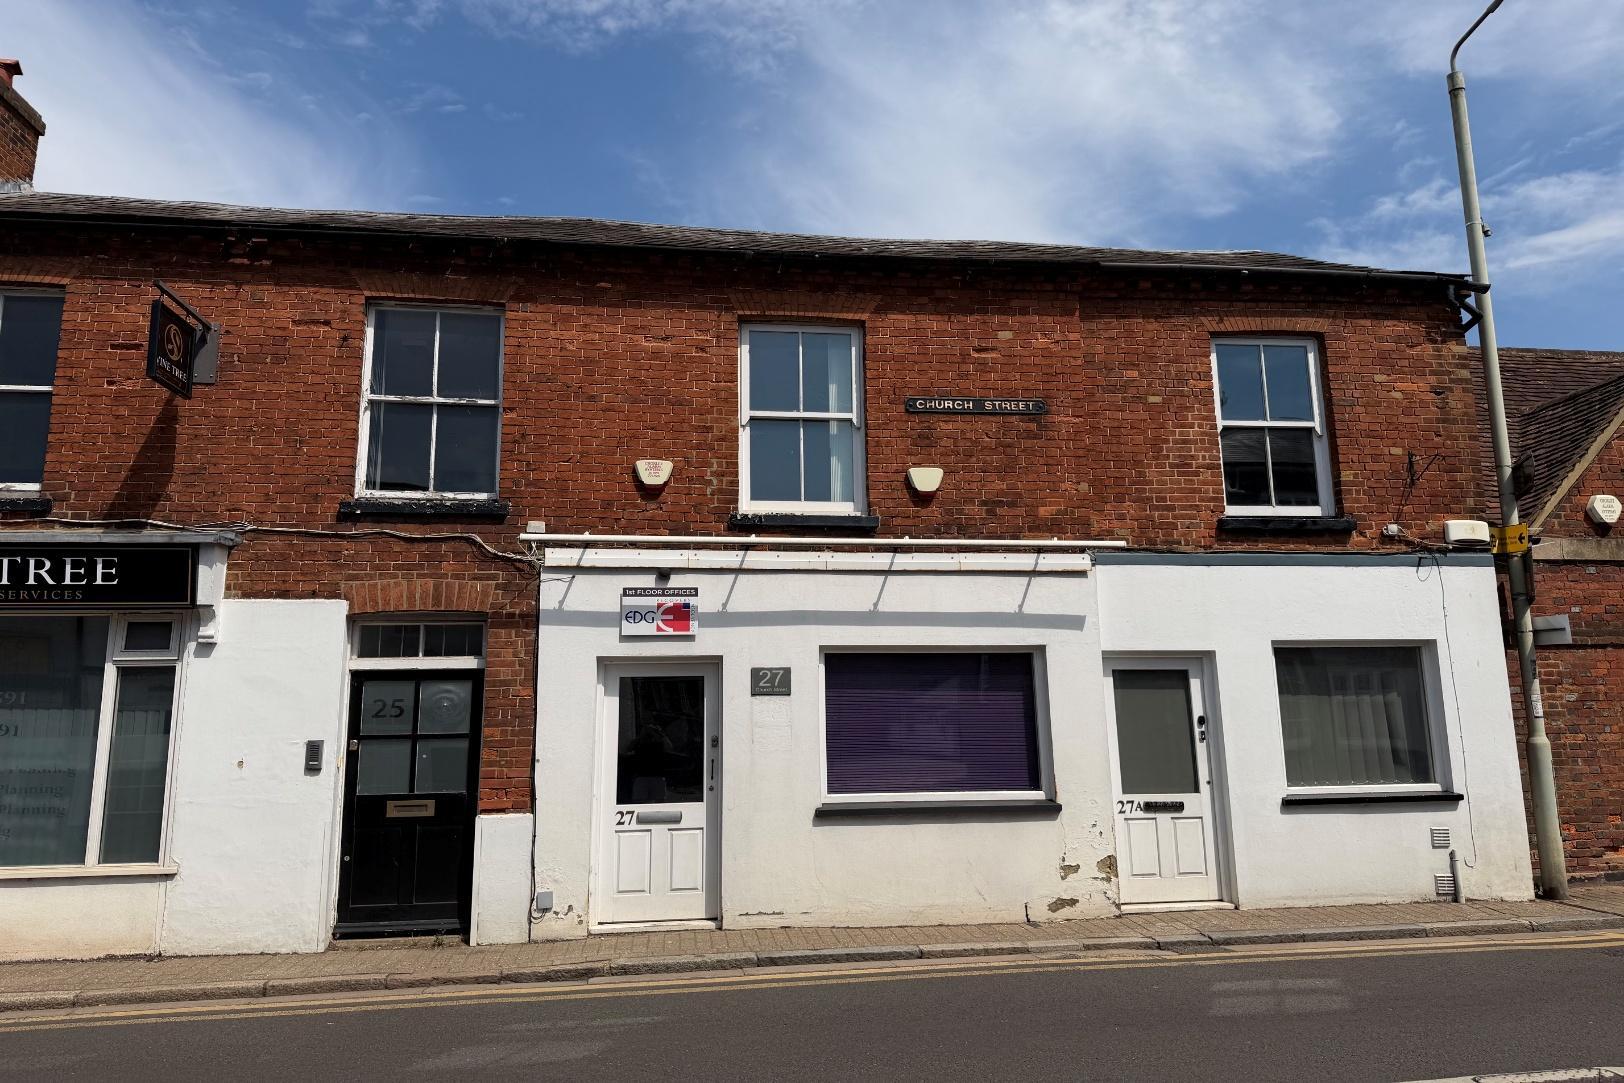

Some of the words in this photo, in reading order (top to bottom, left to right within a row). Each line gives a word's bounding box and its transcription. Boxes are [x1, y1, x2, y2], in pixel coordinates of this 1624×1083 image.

[171, 365, 187, 382] TREE
[916, 400, 973, 410] CHURCH
[984, 401, 1036, 411] STREET
[0, 556, 119, 585] TREE
[0, 590, 83, 600] SERVICES
[759, 670, 785, 687] 27
[371, 699, 405, 718] 25
[1116, 800, 1143, 814] 27A
[615, 810, 635, 826] 27
